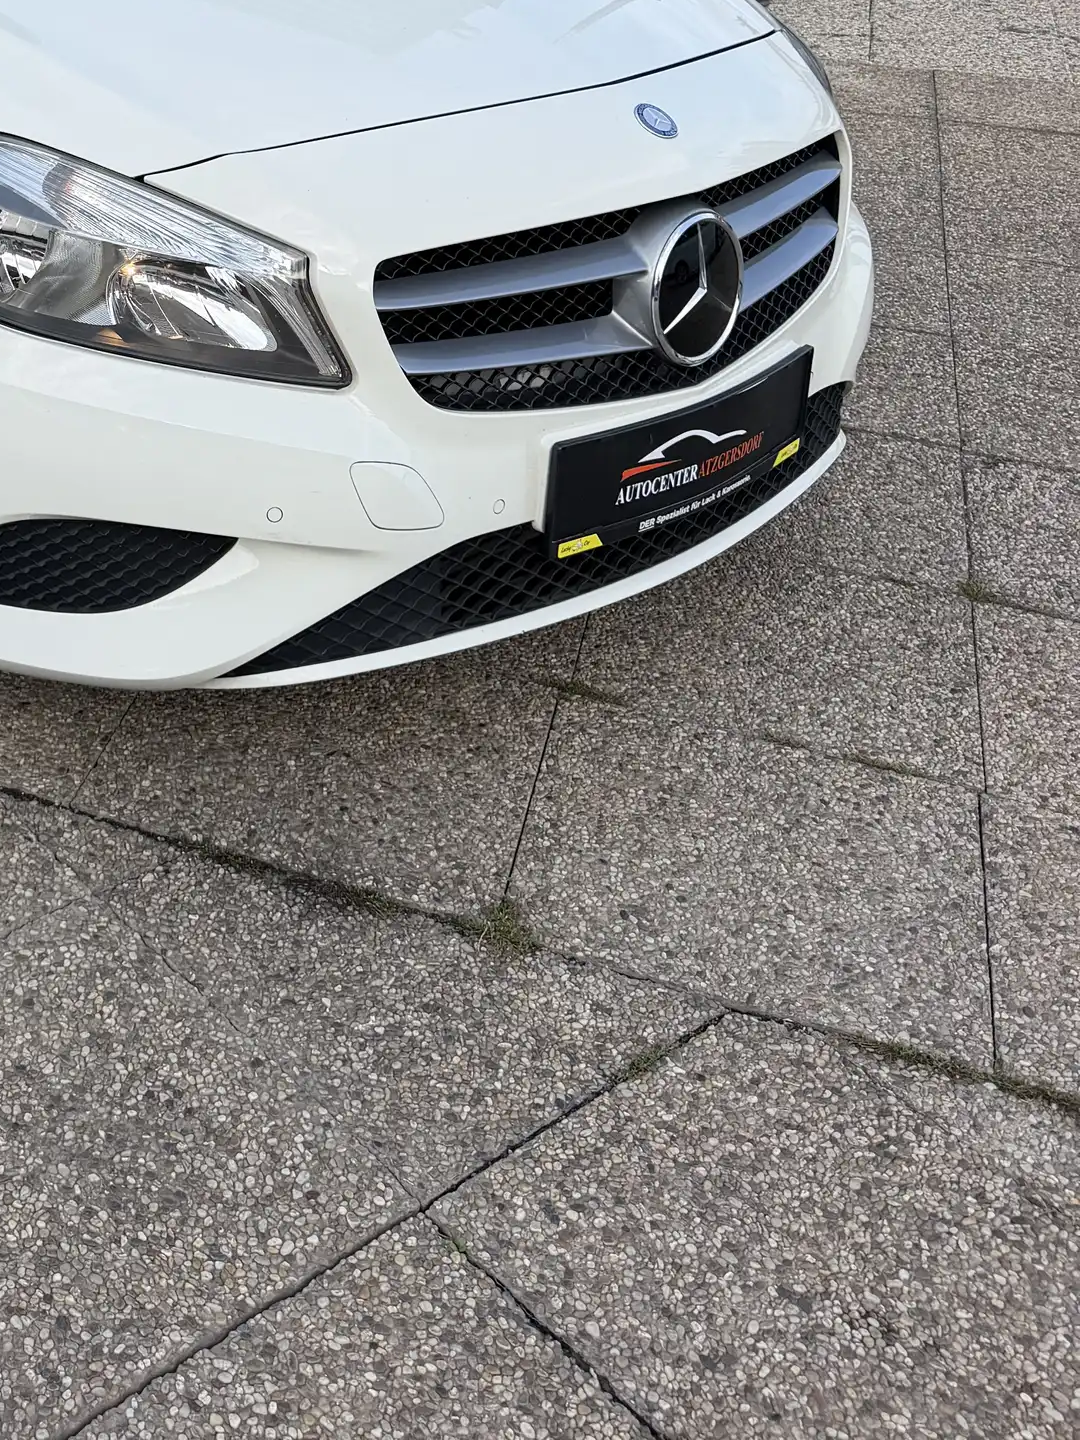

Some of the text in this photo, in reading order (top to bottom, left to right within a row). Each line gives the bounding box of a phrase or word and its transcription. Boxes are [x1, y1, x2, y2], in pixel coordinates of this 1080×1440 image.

[615, 430, 765, 506] AUTOCENTER ATZGERSDORF
[638, 518, 655, 531] DER
[655, 505, 690, 525] Spezialist
[690, 501, 701, 512] für
[701, 493, 716, 506] Lack
